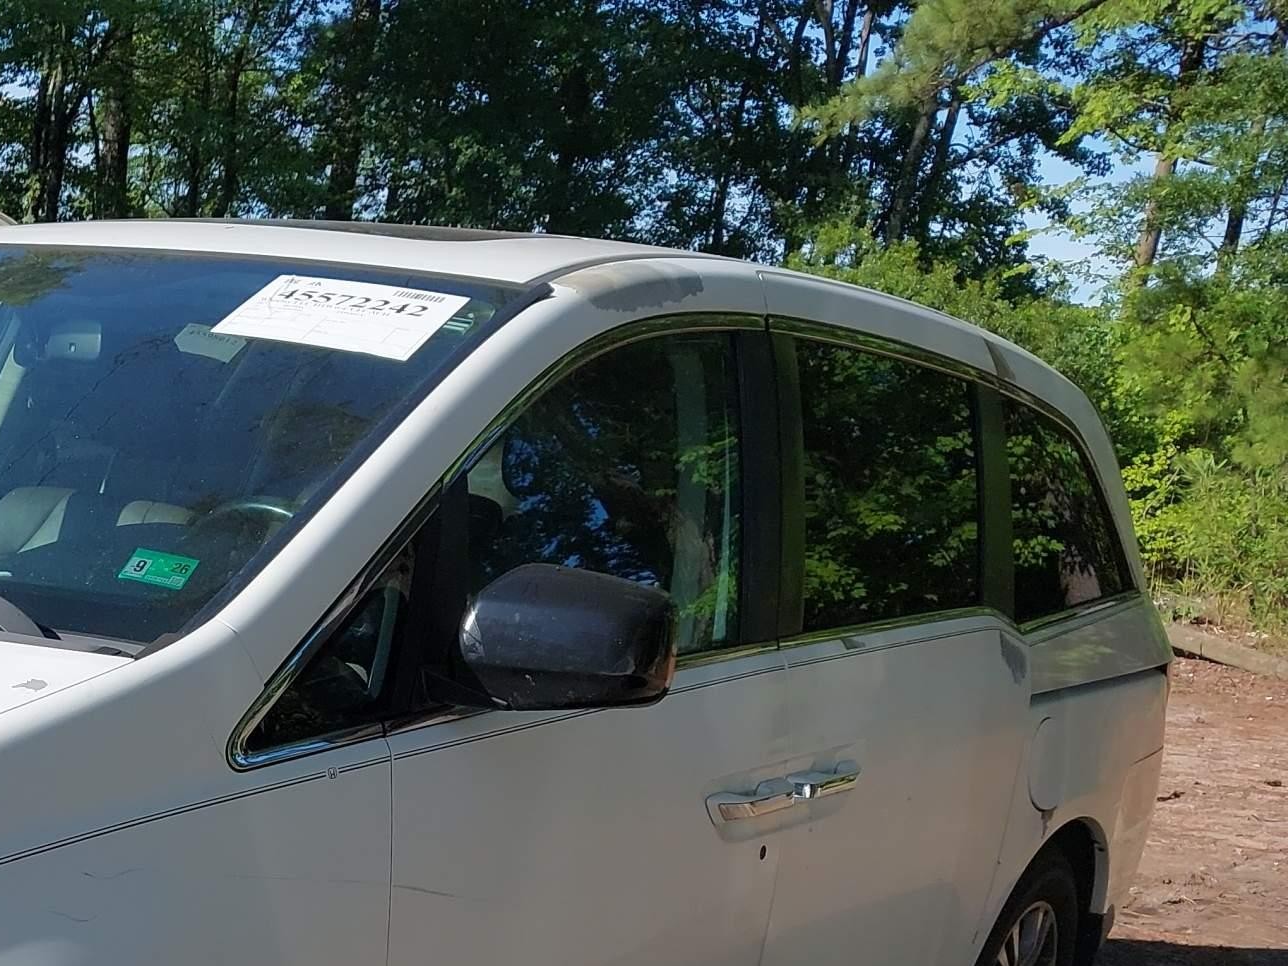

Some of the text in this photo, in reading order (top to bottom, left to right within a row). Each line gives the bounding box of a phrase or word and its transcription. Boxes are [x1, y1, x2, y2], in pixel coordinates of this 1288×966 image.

[277, 288, 429, 318] 45572242
[133, 560, 191, 575] 9 26
